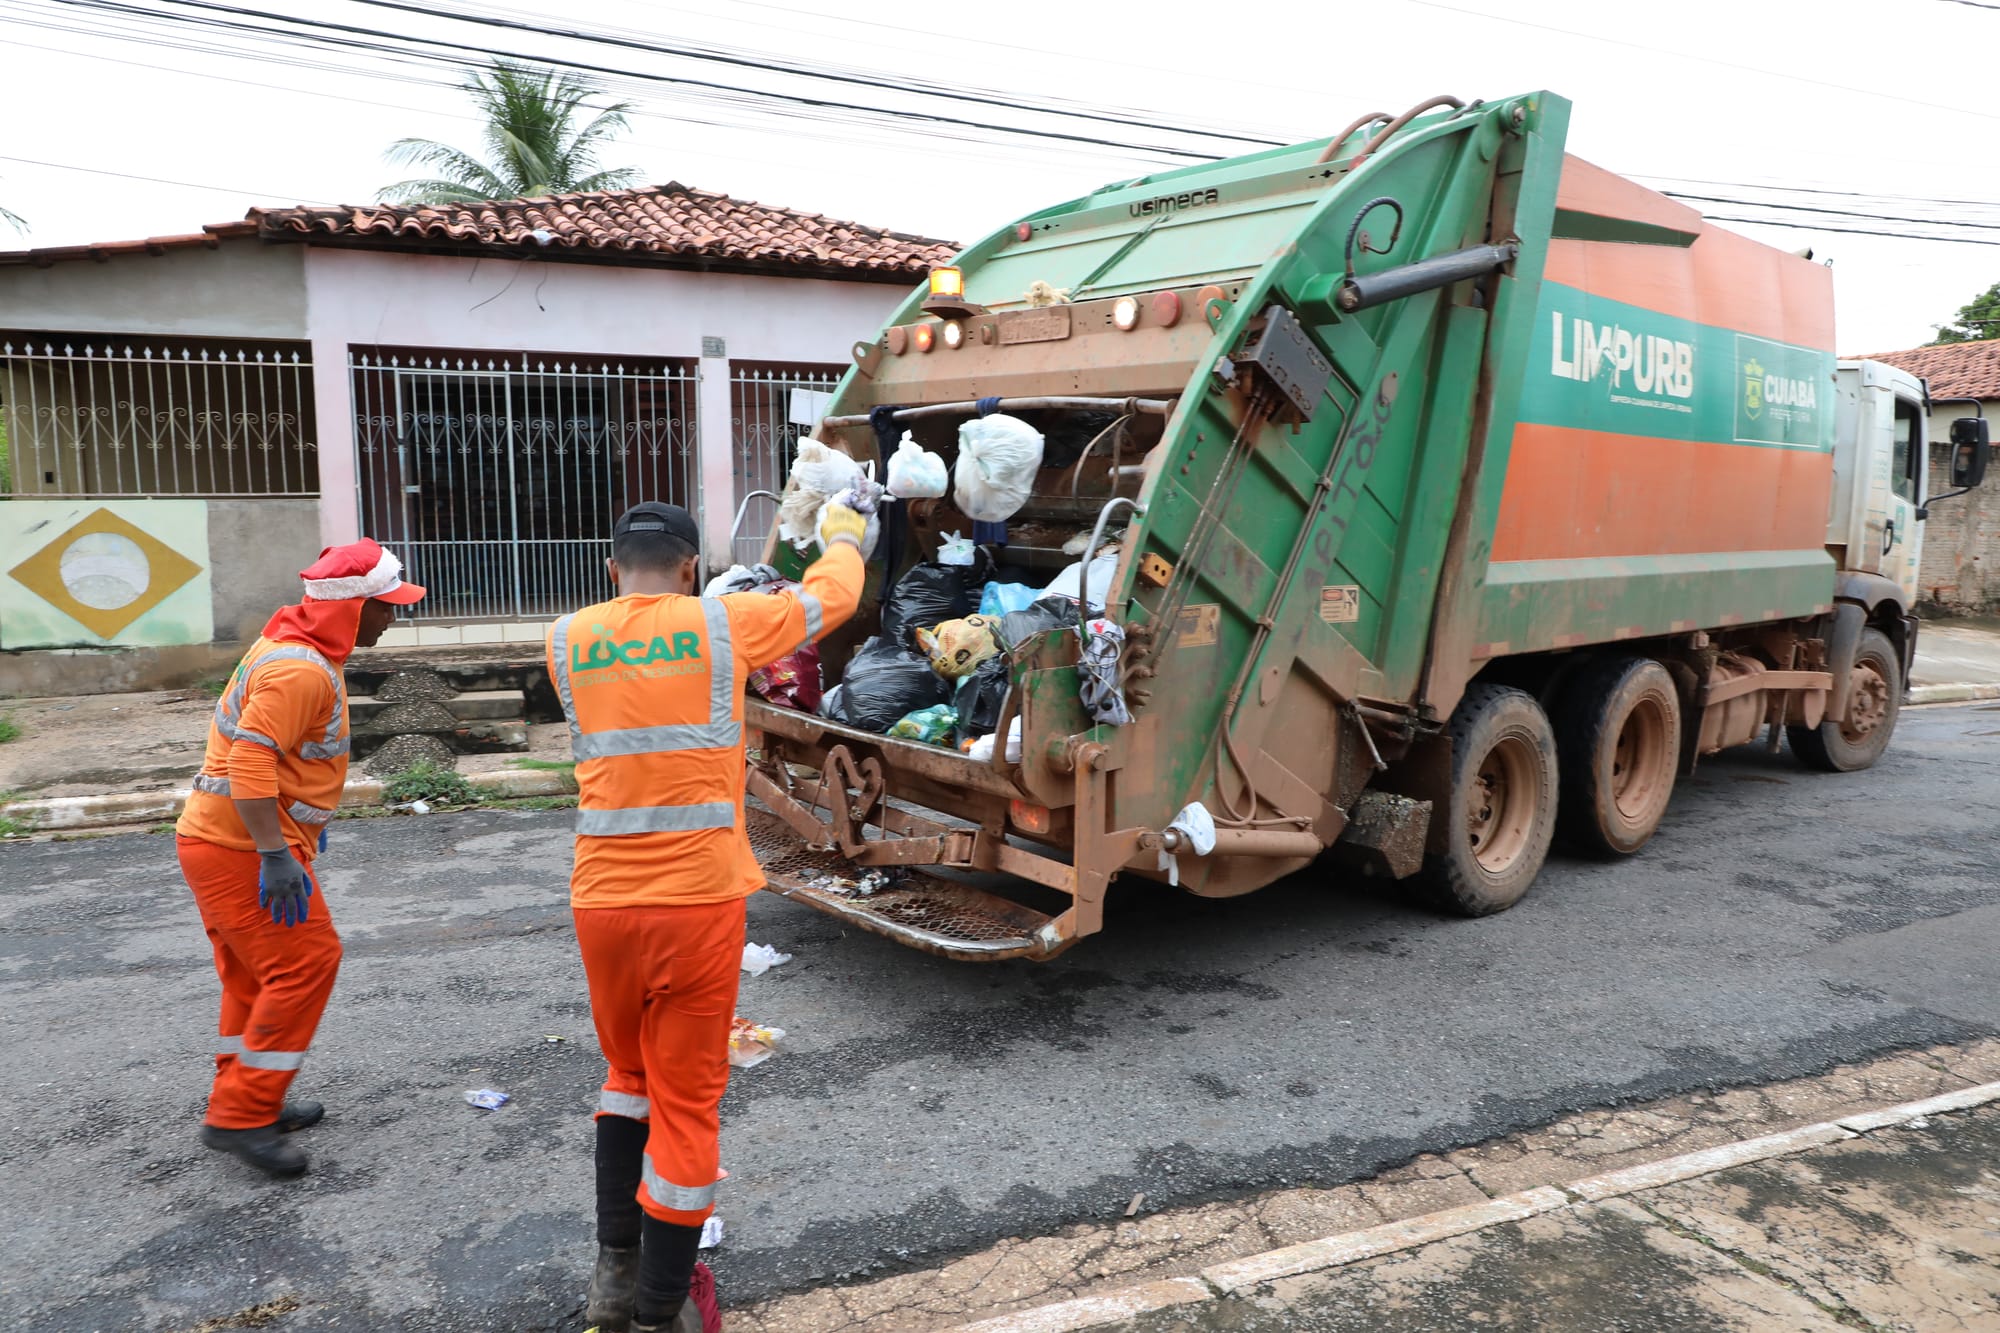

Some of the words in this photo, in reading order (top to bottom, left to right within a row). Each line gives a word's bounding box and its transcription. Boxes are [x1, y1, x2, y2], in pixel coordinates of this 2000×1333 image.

[1130, 188, 1218, 217] usimeca
[1552, 311, 1693, 398] LIMPURB
[1764, 374, 1816, 408] CUIABÁ
[572, 630, 702, 672] LOCAR
[622, 669, 639, 681] DE
